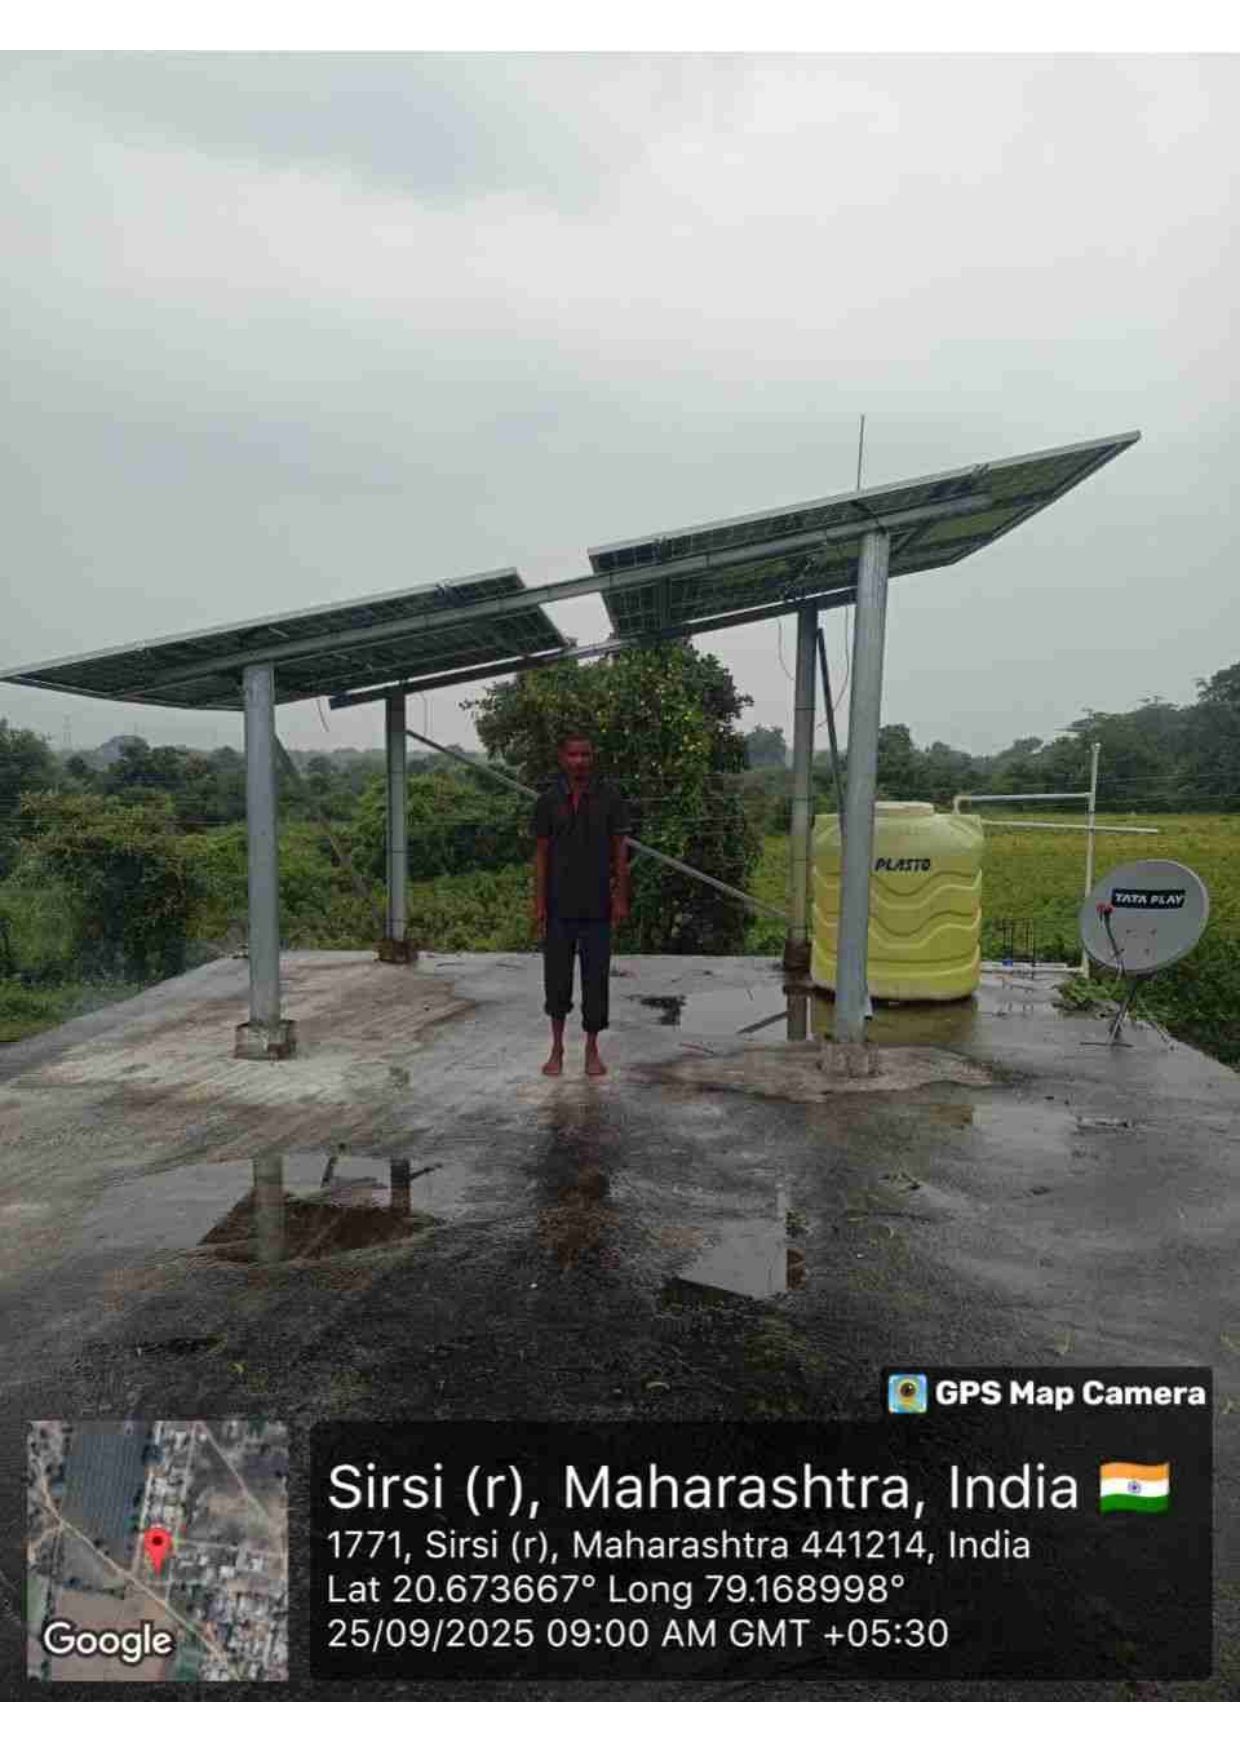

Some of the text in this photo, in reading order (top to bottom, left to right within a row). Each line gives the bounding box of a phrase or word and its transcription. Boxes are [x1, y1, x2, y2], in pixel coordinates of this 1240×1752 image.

[875, 858, 931, 872] PLASTO
[1115, 893, 1182, 906] TATA PLAY
